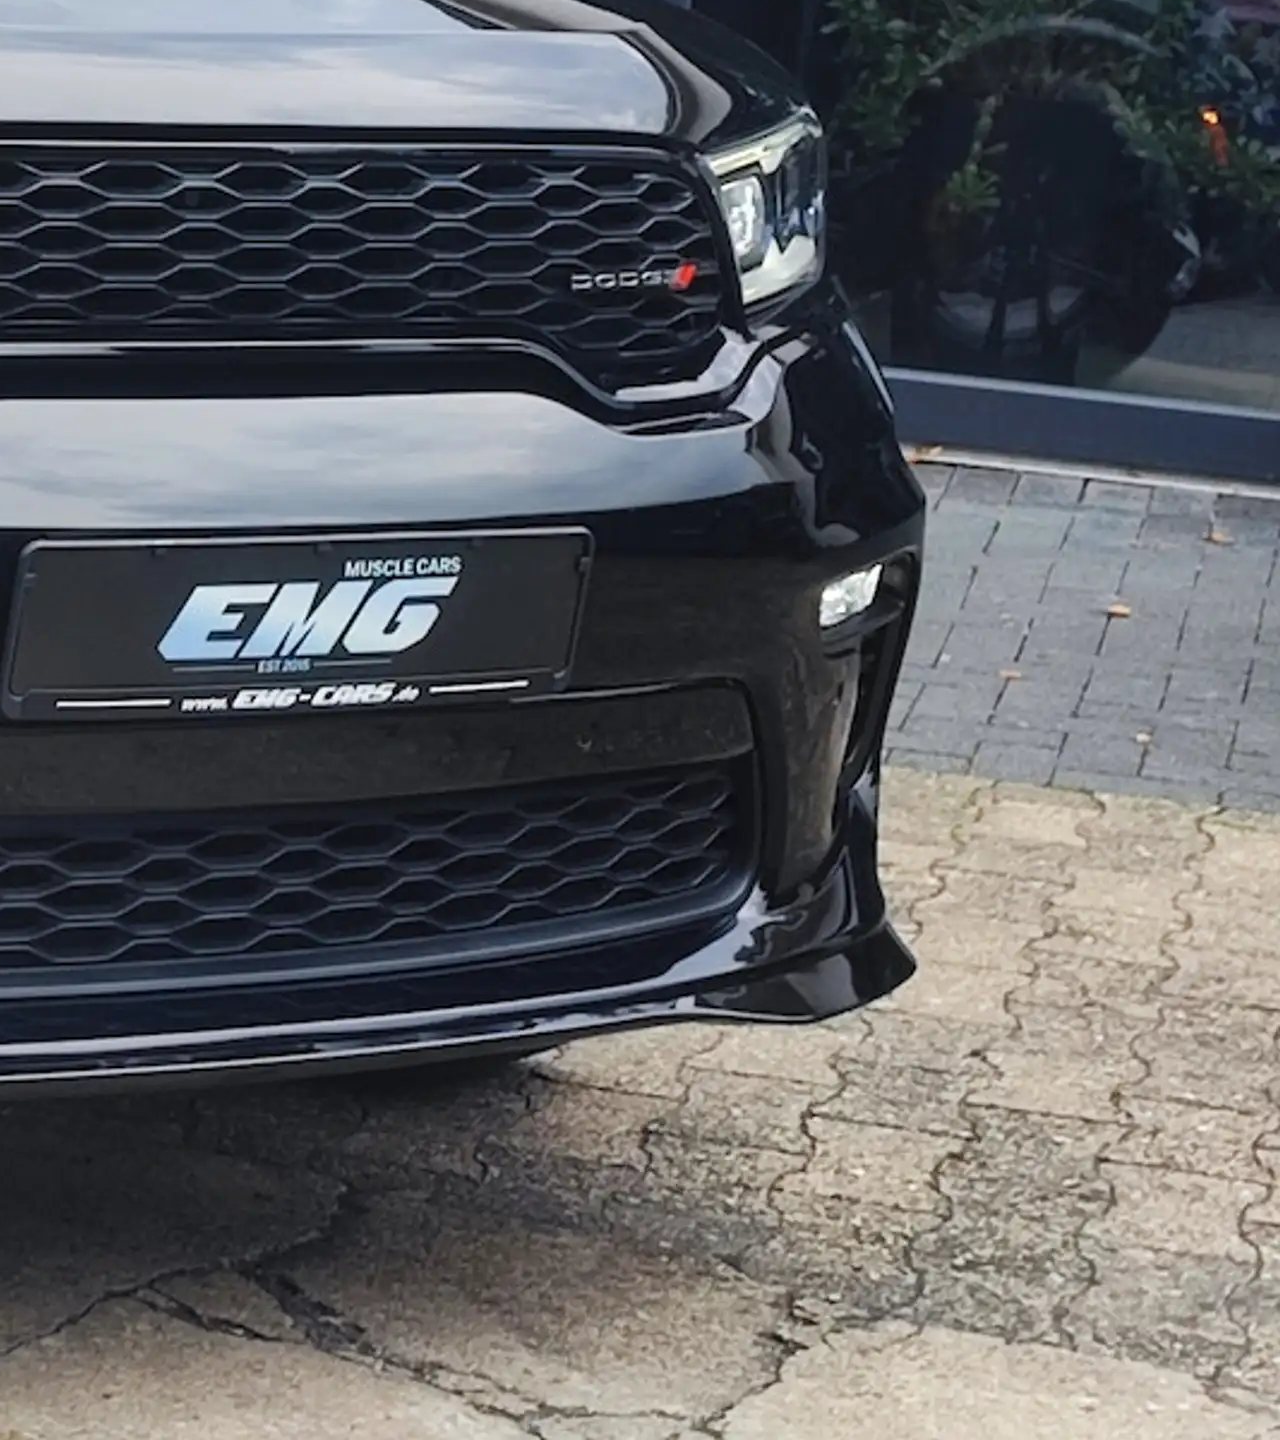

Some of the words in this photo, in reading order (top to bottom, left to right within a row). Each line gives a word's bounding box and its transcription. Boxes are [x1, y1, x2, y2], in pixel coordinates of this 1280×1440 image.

[344, 559, 415, 578] MUSCLE
[416, 556, 462, 575] CARS
[156, 576, 459, 661] EMG
